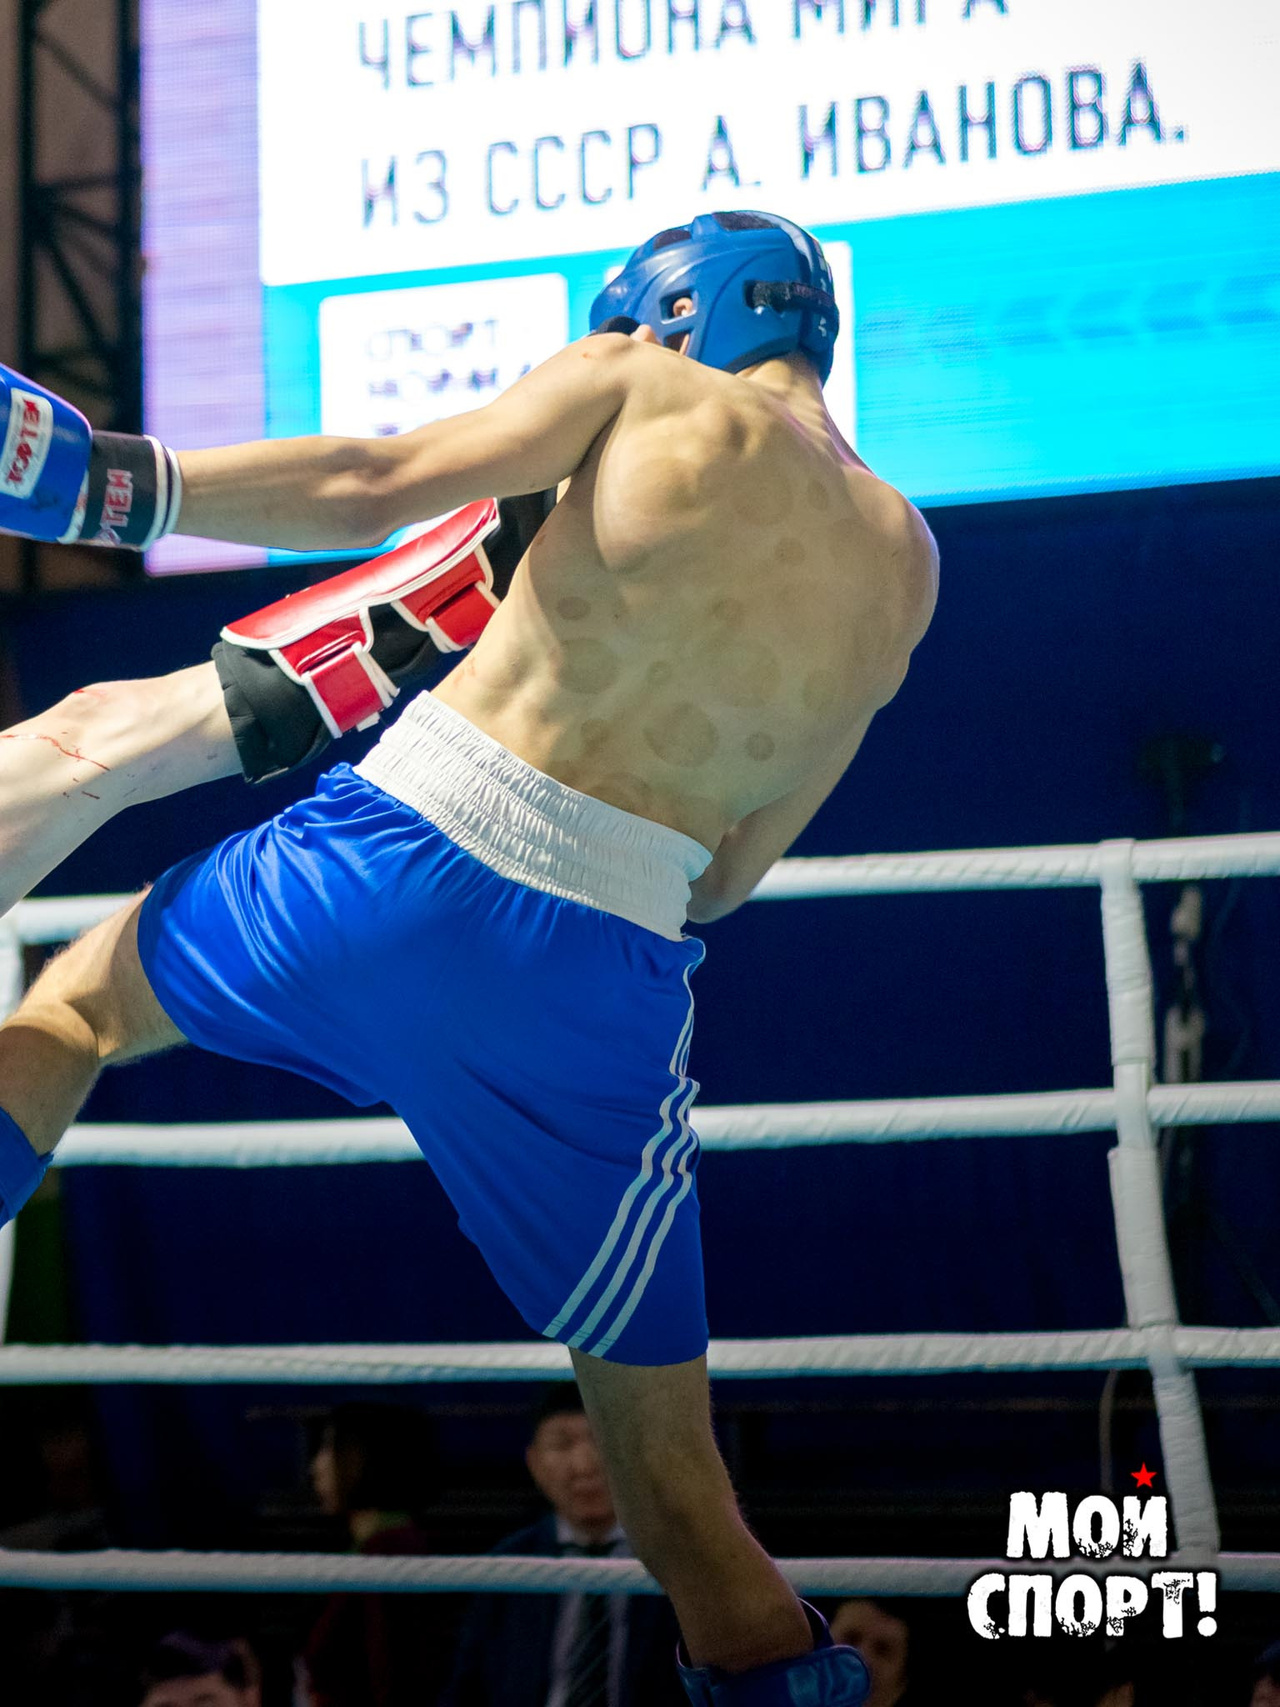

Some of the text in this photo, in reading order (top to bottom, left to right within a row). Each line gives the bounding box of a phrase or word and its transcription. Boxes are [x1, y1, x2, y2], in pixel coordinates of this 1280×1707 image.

[358, 0, 756, 89] ЧЕМПИОНА
[362, 153, 448, 229] ИЗ
[486, 123, 662, 217] СССР
[799, 58, 1185, 180] ИВАНОВА.
